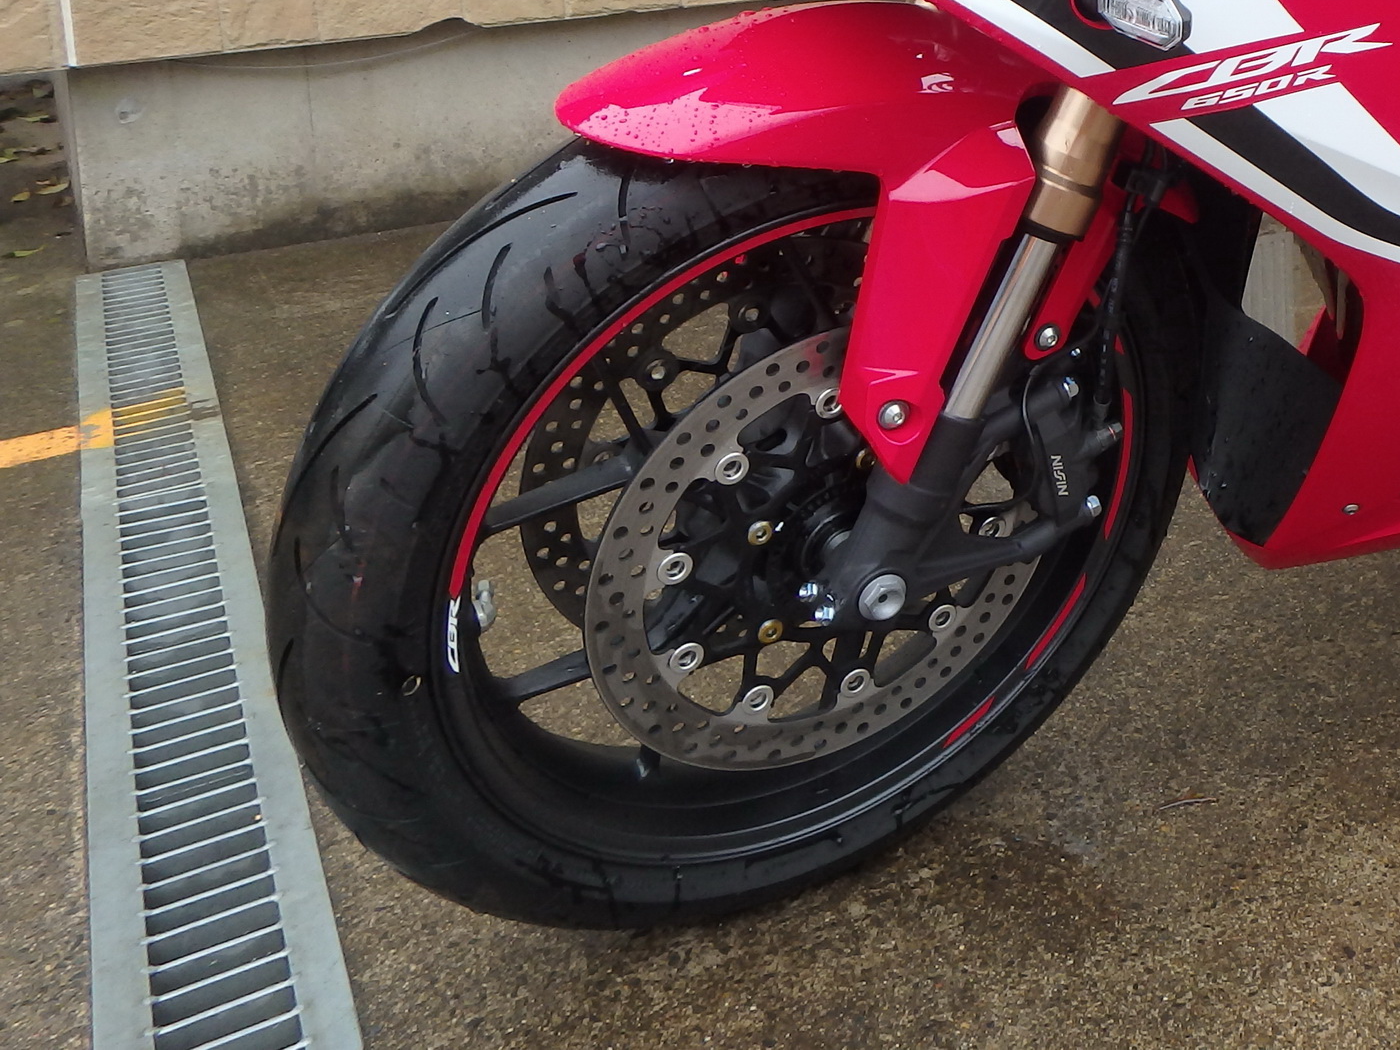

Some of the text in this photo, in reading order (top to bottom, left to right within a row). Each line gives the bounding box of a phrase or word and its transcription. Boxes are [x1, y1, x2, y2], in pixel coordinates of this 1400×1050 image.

[1112, 23, 1393, 105] CBR
[1180, 63, 1336, 111] 650R
[1050, 454, 1069, 496] NISSIN
